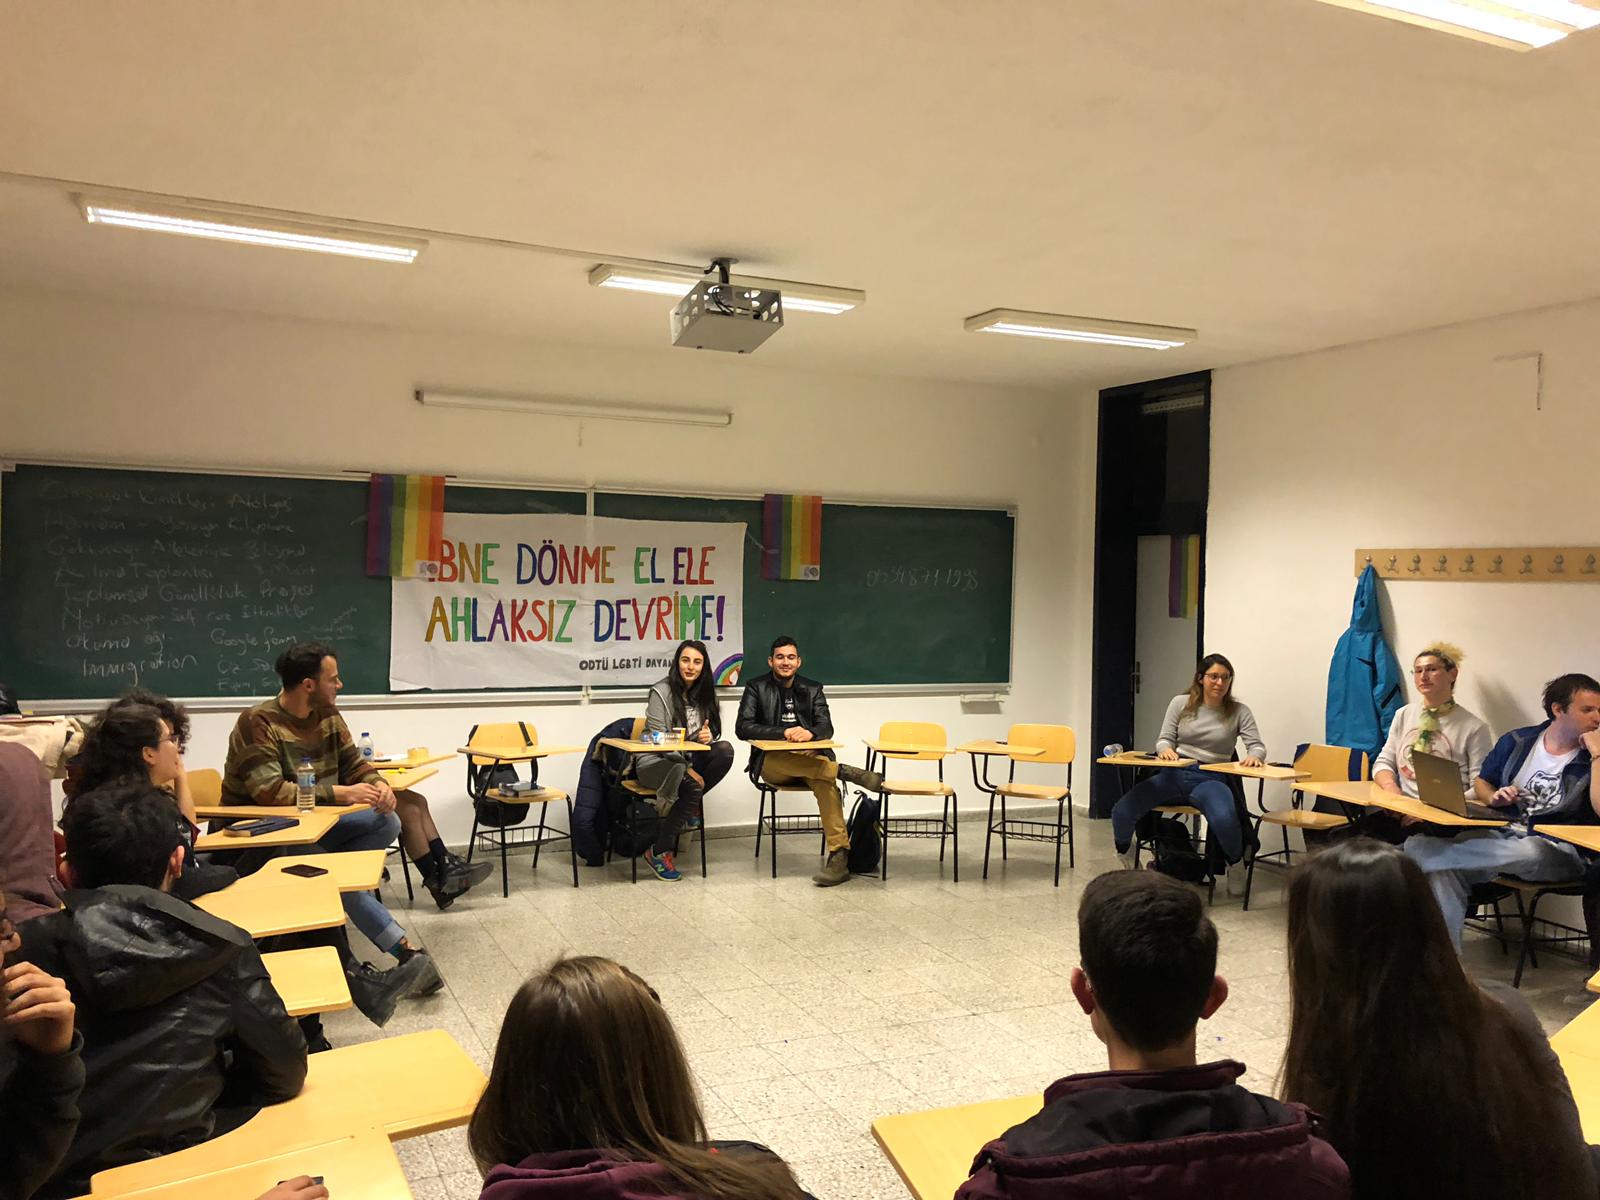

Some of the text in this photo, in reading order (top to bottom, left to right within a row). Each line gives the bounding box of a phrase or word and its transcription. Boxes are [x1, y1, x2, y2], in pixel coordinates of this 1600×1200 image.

[427, 539, 716, 586] BNE DÖNME EL ELE
[425, 590, 727, 643] AHLAKSIZ DEVRİME!
[210, 626, 297, 656] Google form
[83, 653, 198, 688] Immigration
[579, 657, 609, 671] ODTÜ
[612, 656, 642, 670] LGBTİ
